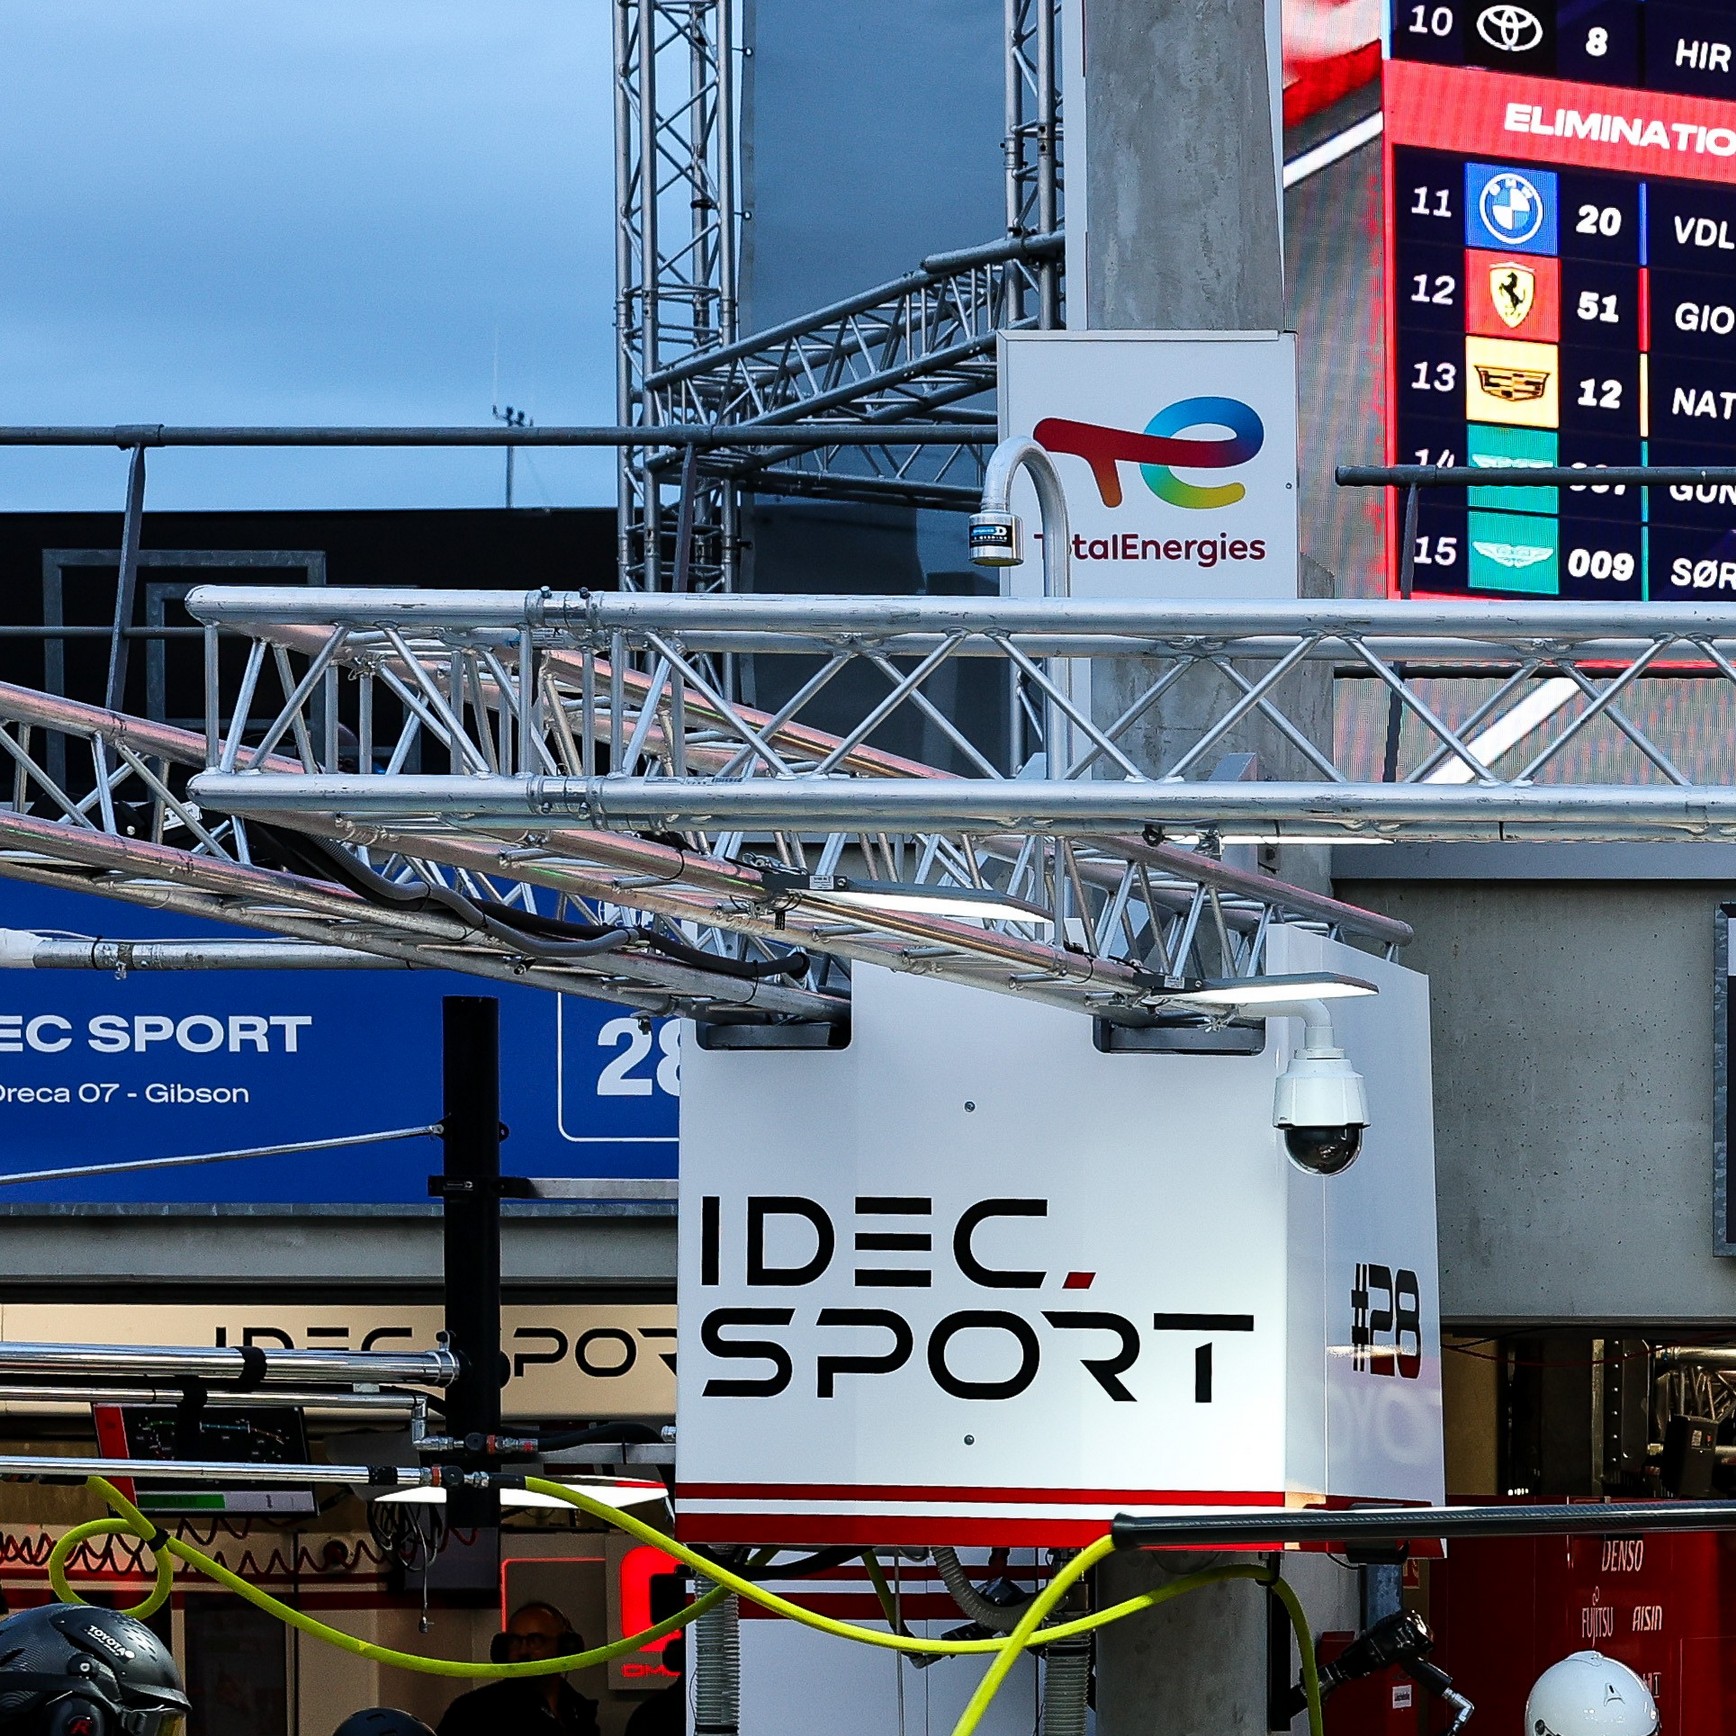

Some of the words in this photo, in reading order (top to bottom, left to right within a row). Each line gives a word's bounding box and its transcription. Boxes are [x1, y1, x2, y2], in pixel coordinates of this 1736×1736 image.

[1409, 5, 1453, 36] 10
[1586, 28, 1608, 56] 8
[1675, 39, 1732, 72] HIR
[1411, 186, 1452, 217] 11
[1577, 205, 1621, 236] 20
[1674, 216, 1734, 250] VDL
[1411, 274, 1454, 304] 12
[1578, 294, 1619, 323] 51
[1675, 303, 1735, 336] GIO
[1412, 361, 1456, 391] 13
[1578, 379, 1622, 410] 12
[1034, 533, 1265, 567] talEnergies
[1415, 536, 1456, 567] 15
[1568, 549, 1634, 581] 009
[88, 1015, 312, 1052] SPORT
[78, 1082, 119, 1104] 07
[145, 1081, 249, 1104] Gibson
[701, 1196, 1049, 1290] IDEC
[1350, 1261, 1422, 1380] #28
[700, 1308, 1254, 1403] SPORT
[1602, 1540, 1644, 1571] DENSO
[1632, 1606, 1662, 1631] AISIN
